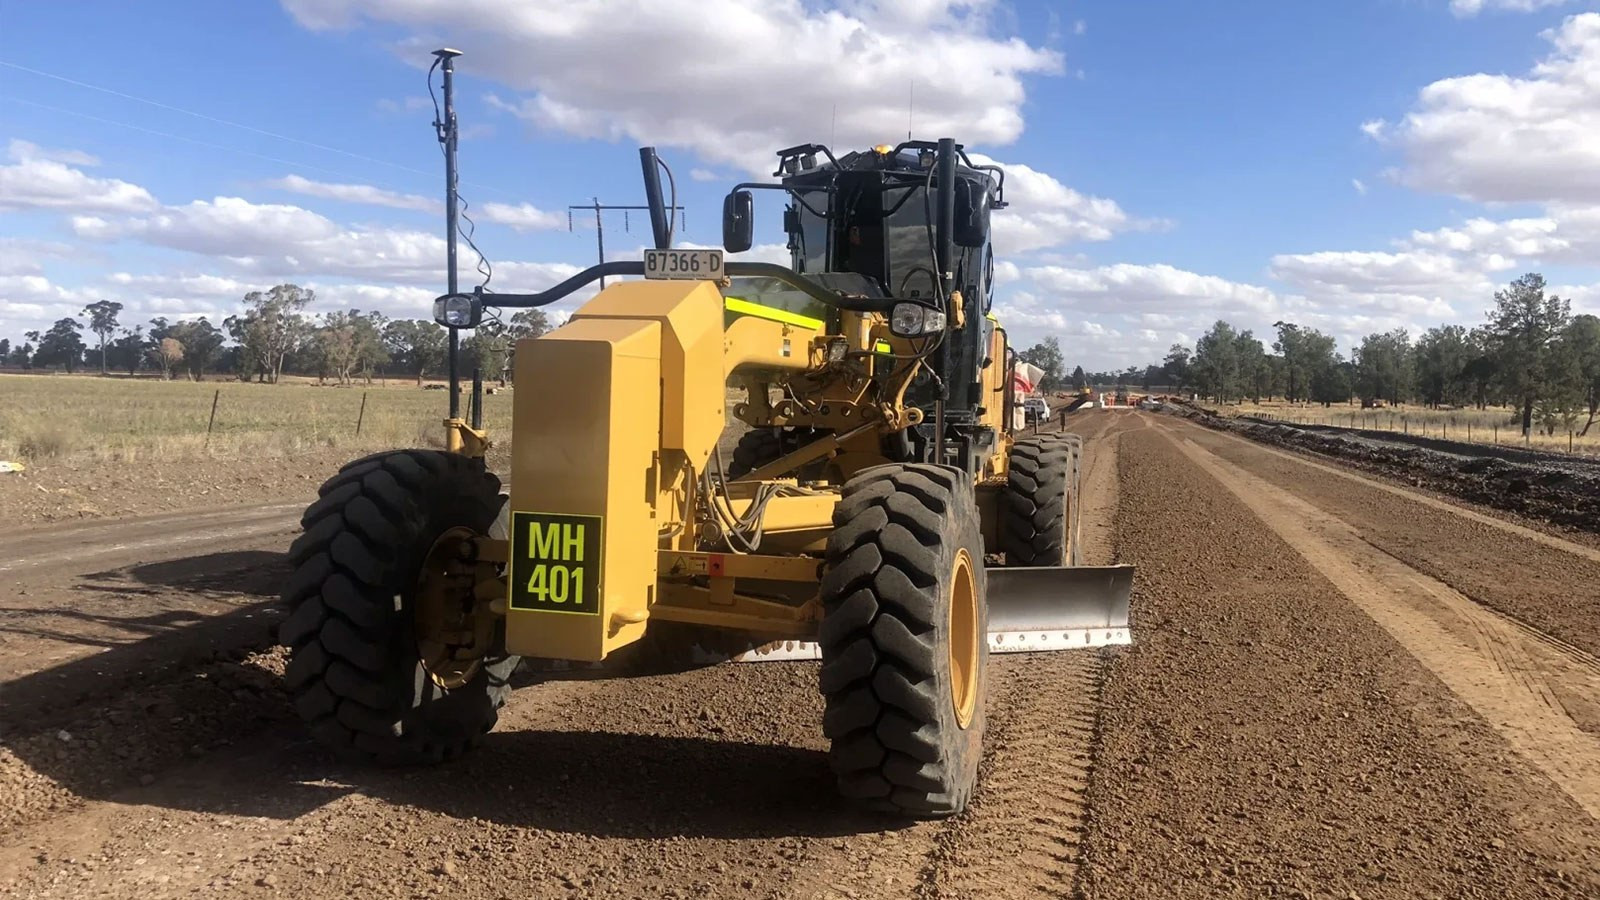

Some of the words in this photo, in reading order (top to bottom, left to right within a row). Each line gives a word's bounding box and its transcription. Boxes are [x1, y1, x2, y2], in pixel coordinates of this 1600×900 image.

[648, 252, 720, 272] 87366-D
[528, 522, 585, 561] MH
[527, 564, 584, 604] 401
